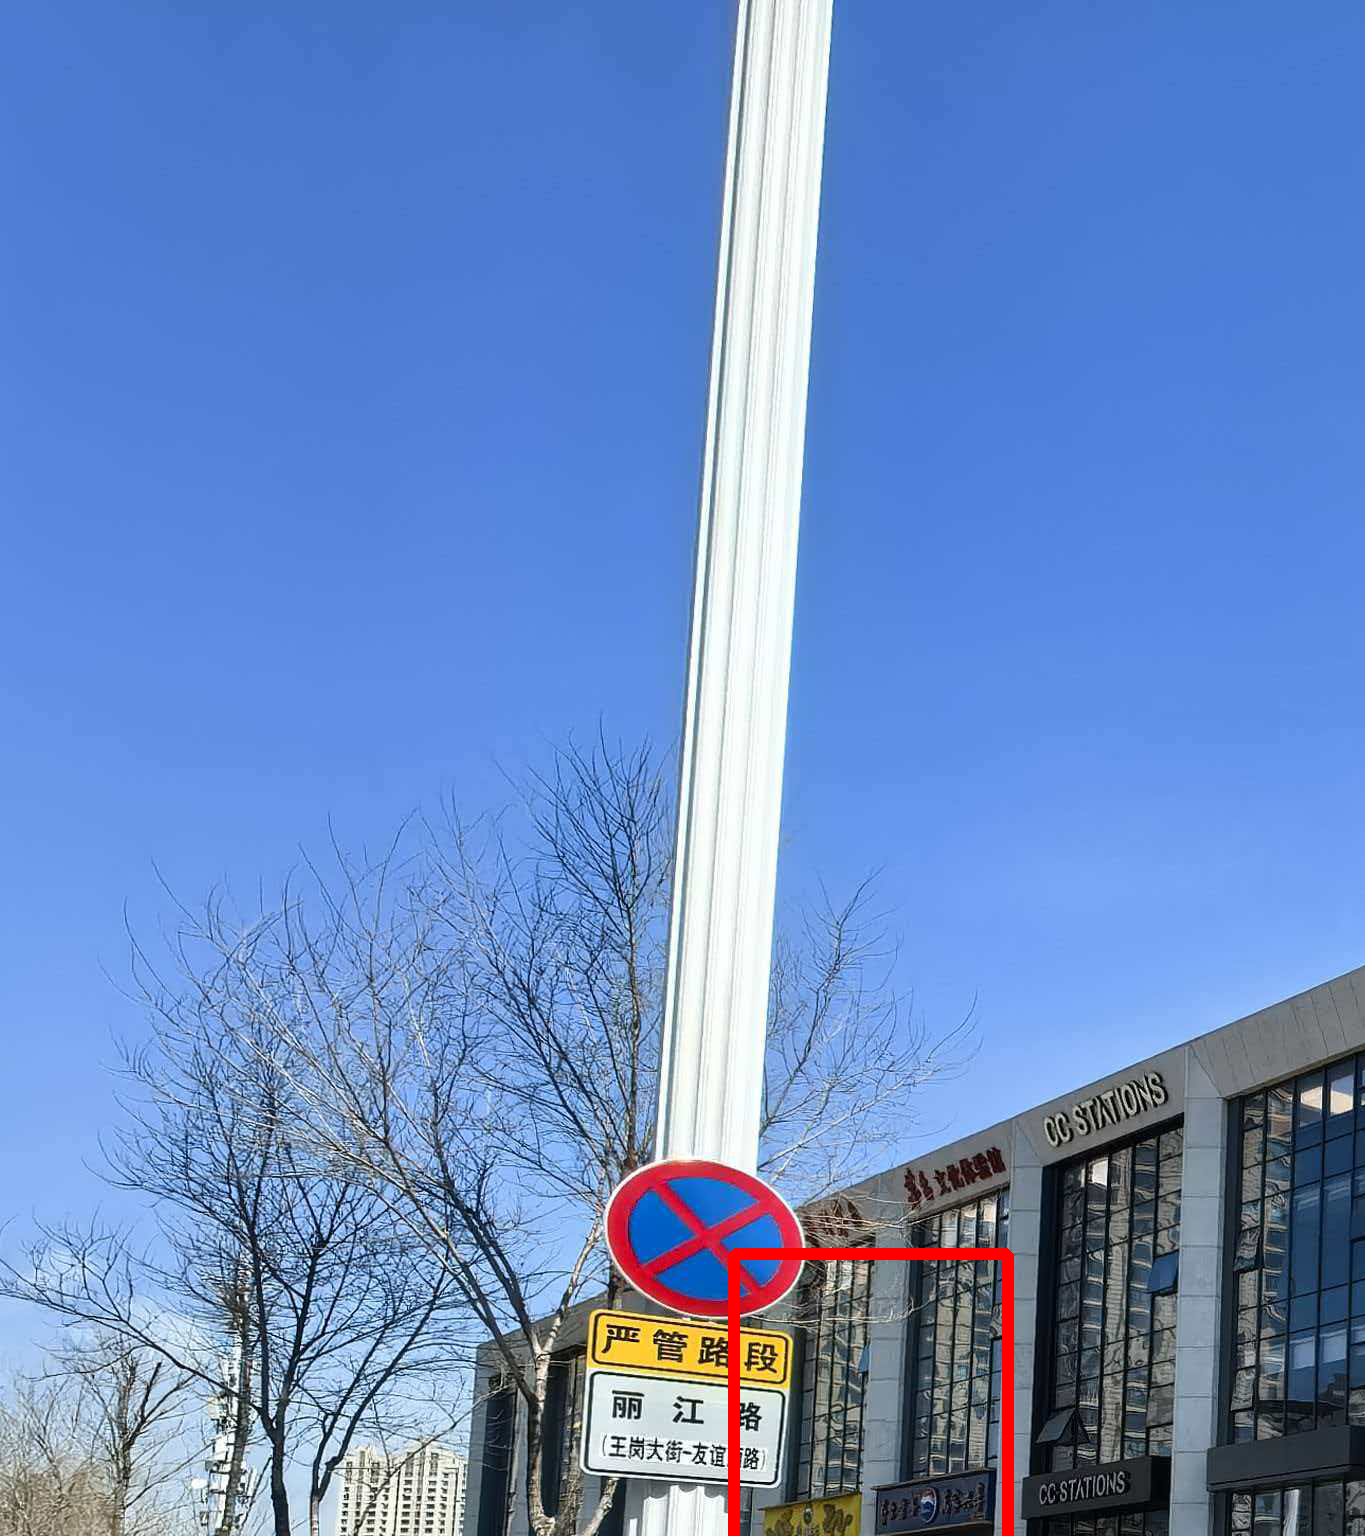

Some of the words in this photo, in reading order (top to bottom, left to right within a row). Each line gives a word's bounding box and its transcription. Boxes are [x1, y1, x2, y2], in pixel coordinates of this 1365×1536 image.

[1044, 1112, 1073, 1147] CC
[1073, 1072, 1168, 1137] STATIONS
[601, 1323, 778, 1374] 严管路段
[611, 1389, 763, 1432] 丽江路
[602, 1435, 766, 1471] (王岗大街-友谊路)
[1040, 1483, 1056, 1504] CC
[1060, 1471, 1125, 1502] STATIONS
